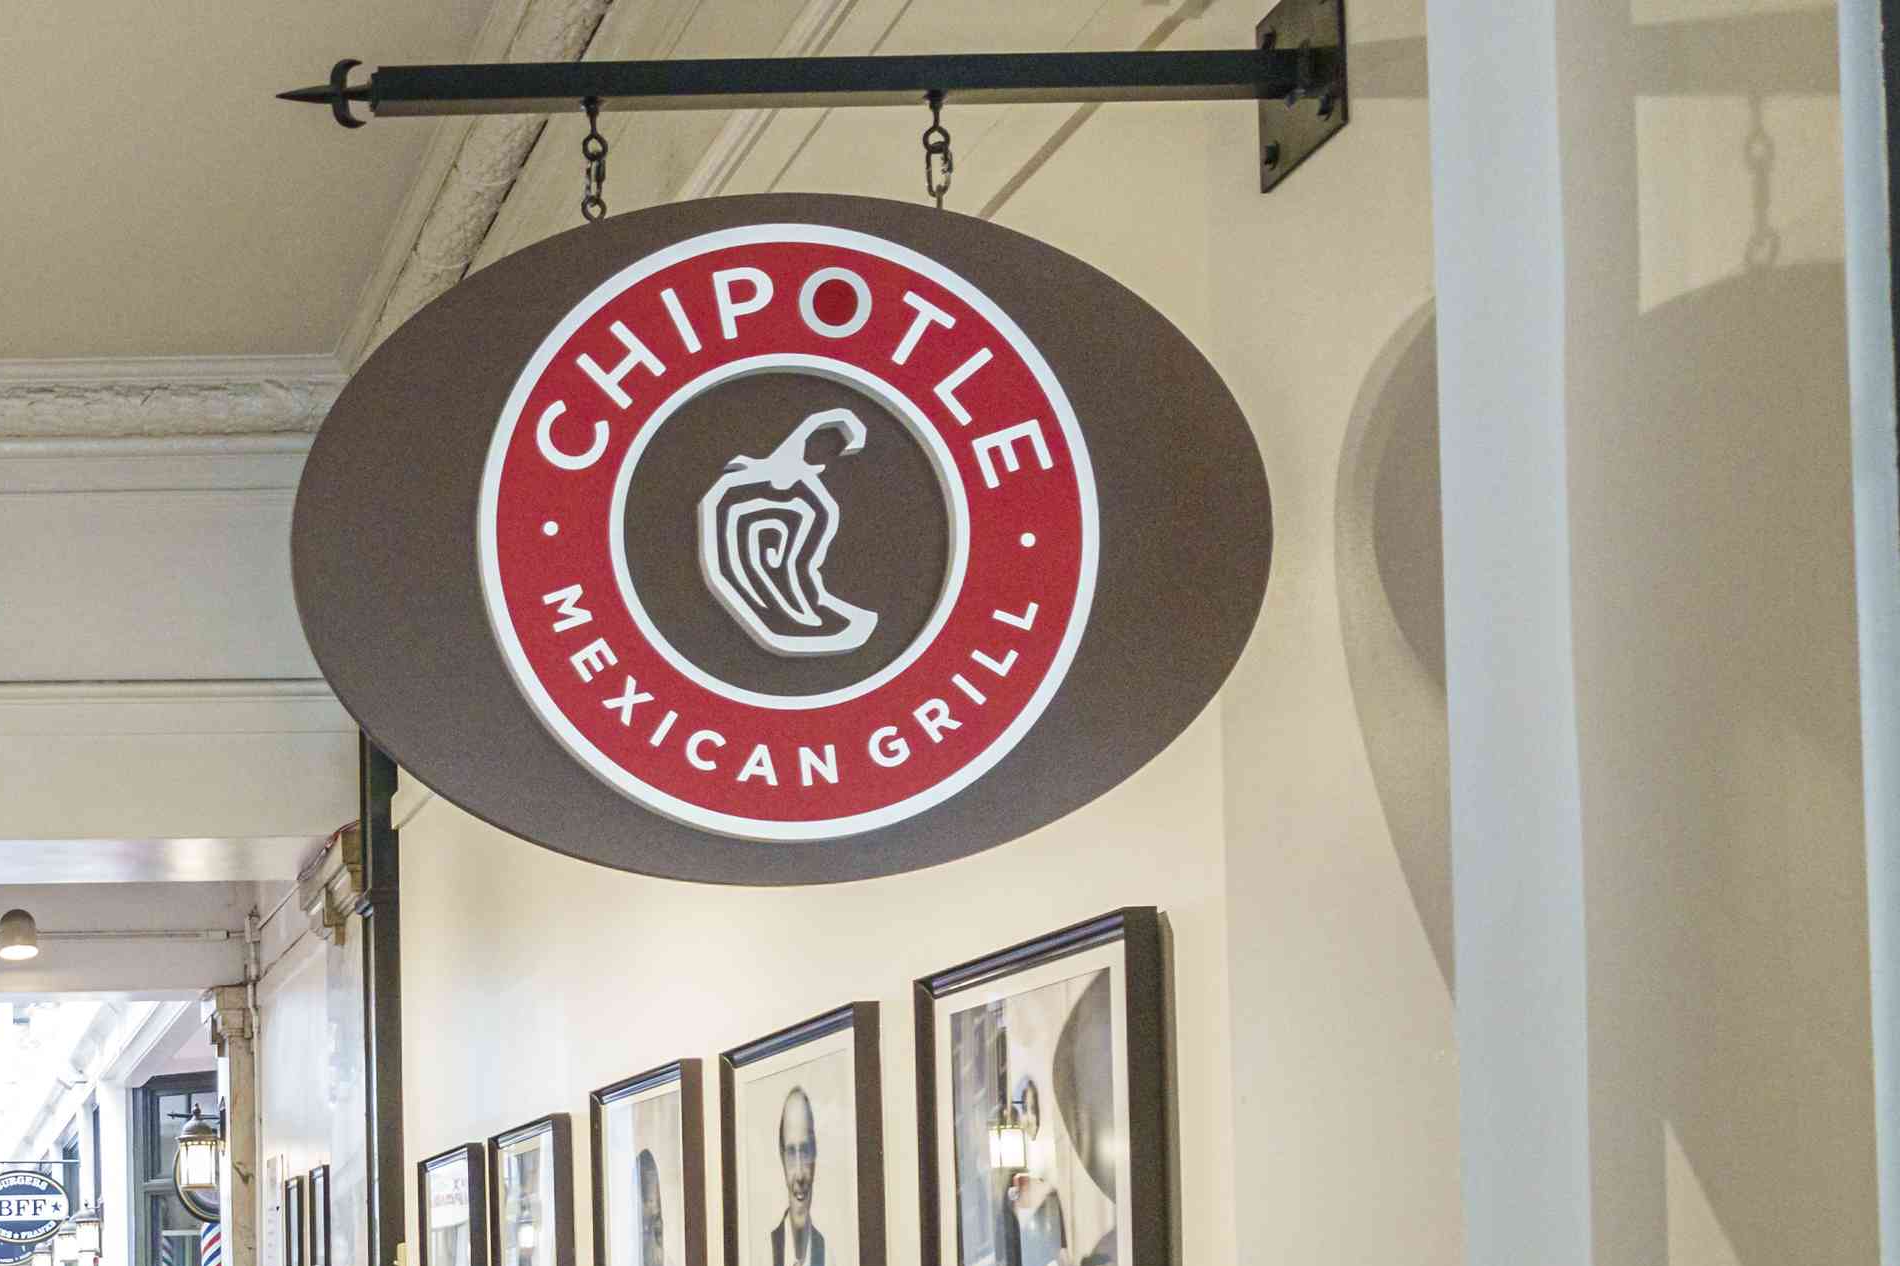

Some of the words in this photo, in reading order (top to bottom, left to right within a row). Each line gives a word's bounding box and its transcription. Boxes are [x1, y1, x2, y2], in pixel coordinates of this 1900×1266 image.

[536, 266, 1054, 489] CHIPOTLE
[542, 584, 839, 788] MEXICAN
[868, 598, 1040, 768] GRILL
